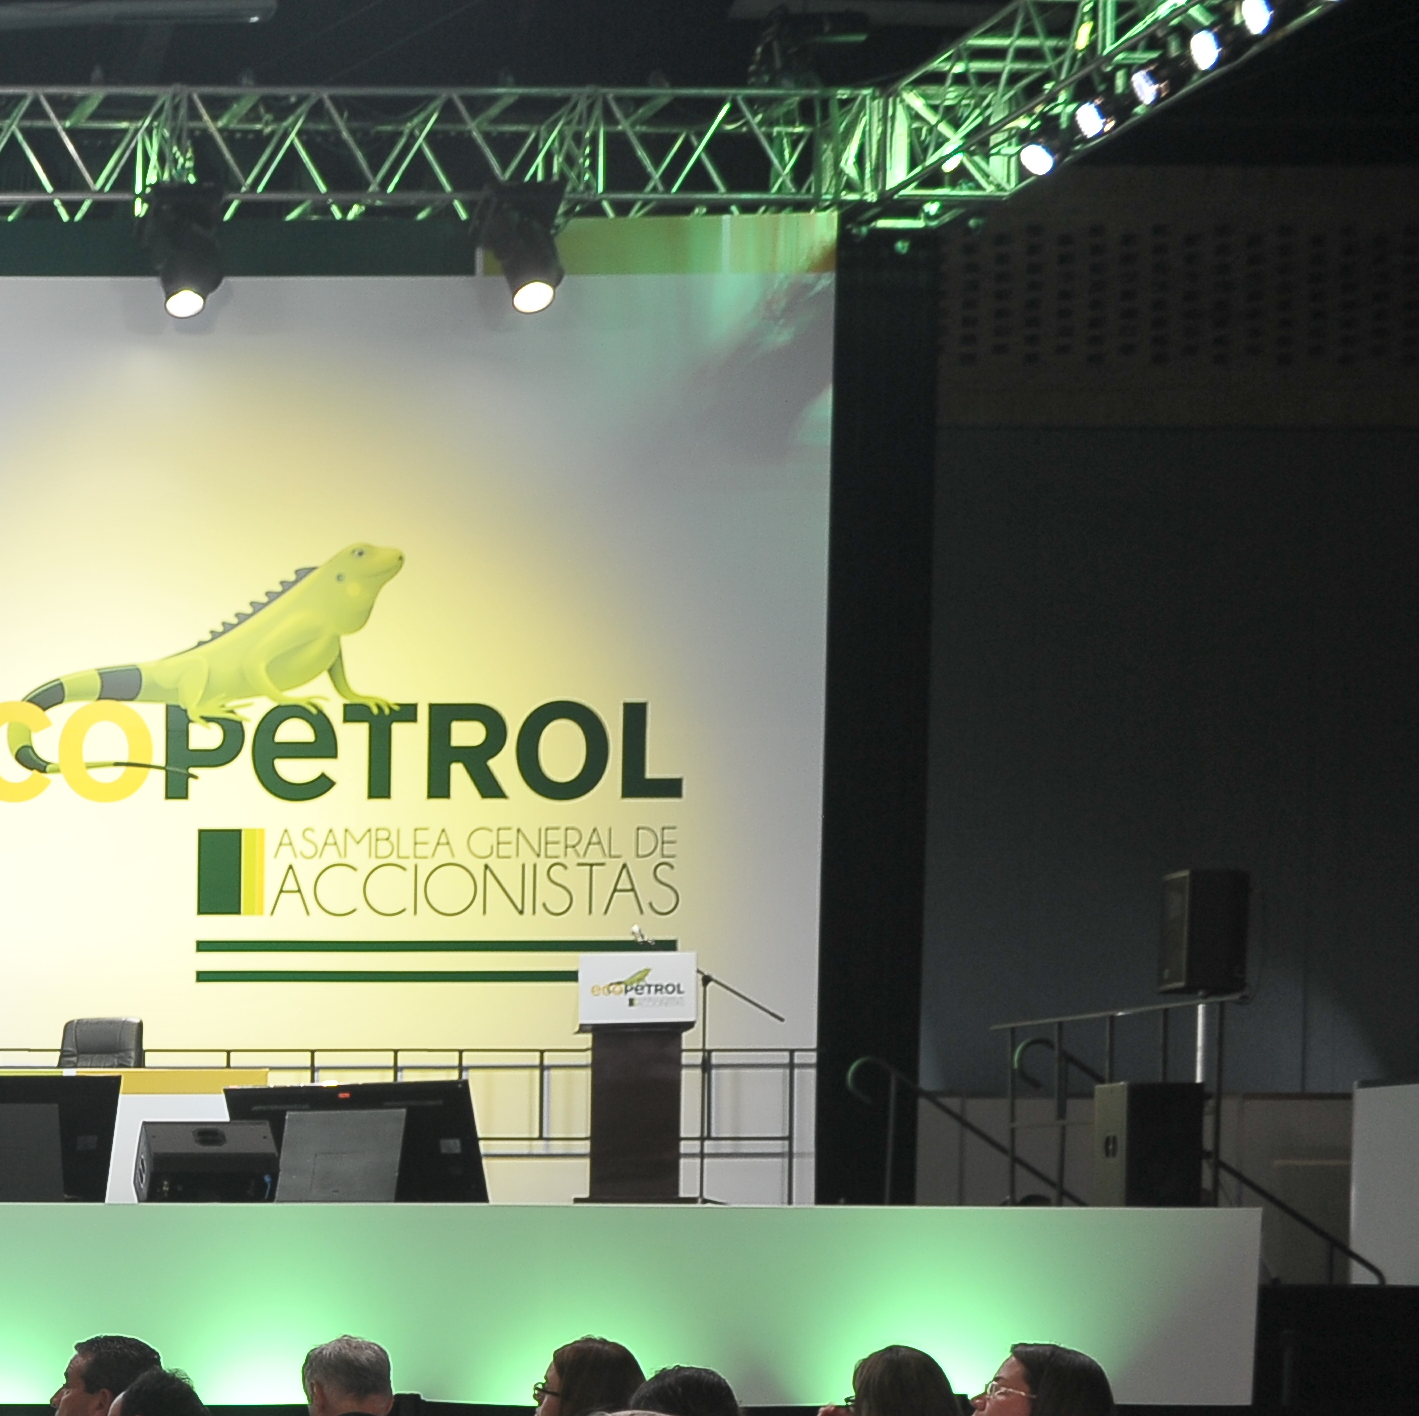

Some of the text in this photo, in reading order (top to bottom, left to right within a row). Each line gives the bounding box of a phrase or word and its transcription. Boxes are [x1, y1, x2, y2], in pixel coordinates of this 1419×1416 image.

[273, 826, 680, 860] ASAMBLEA GENERAL DE
[270, 863, 681, 917] ACCIONISTAS
